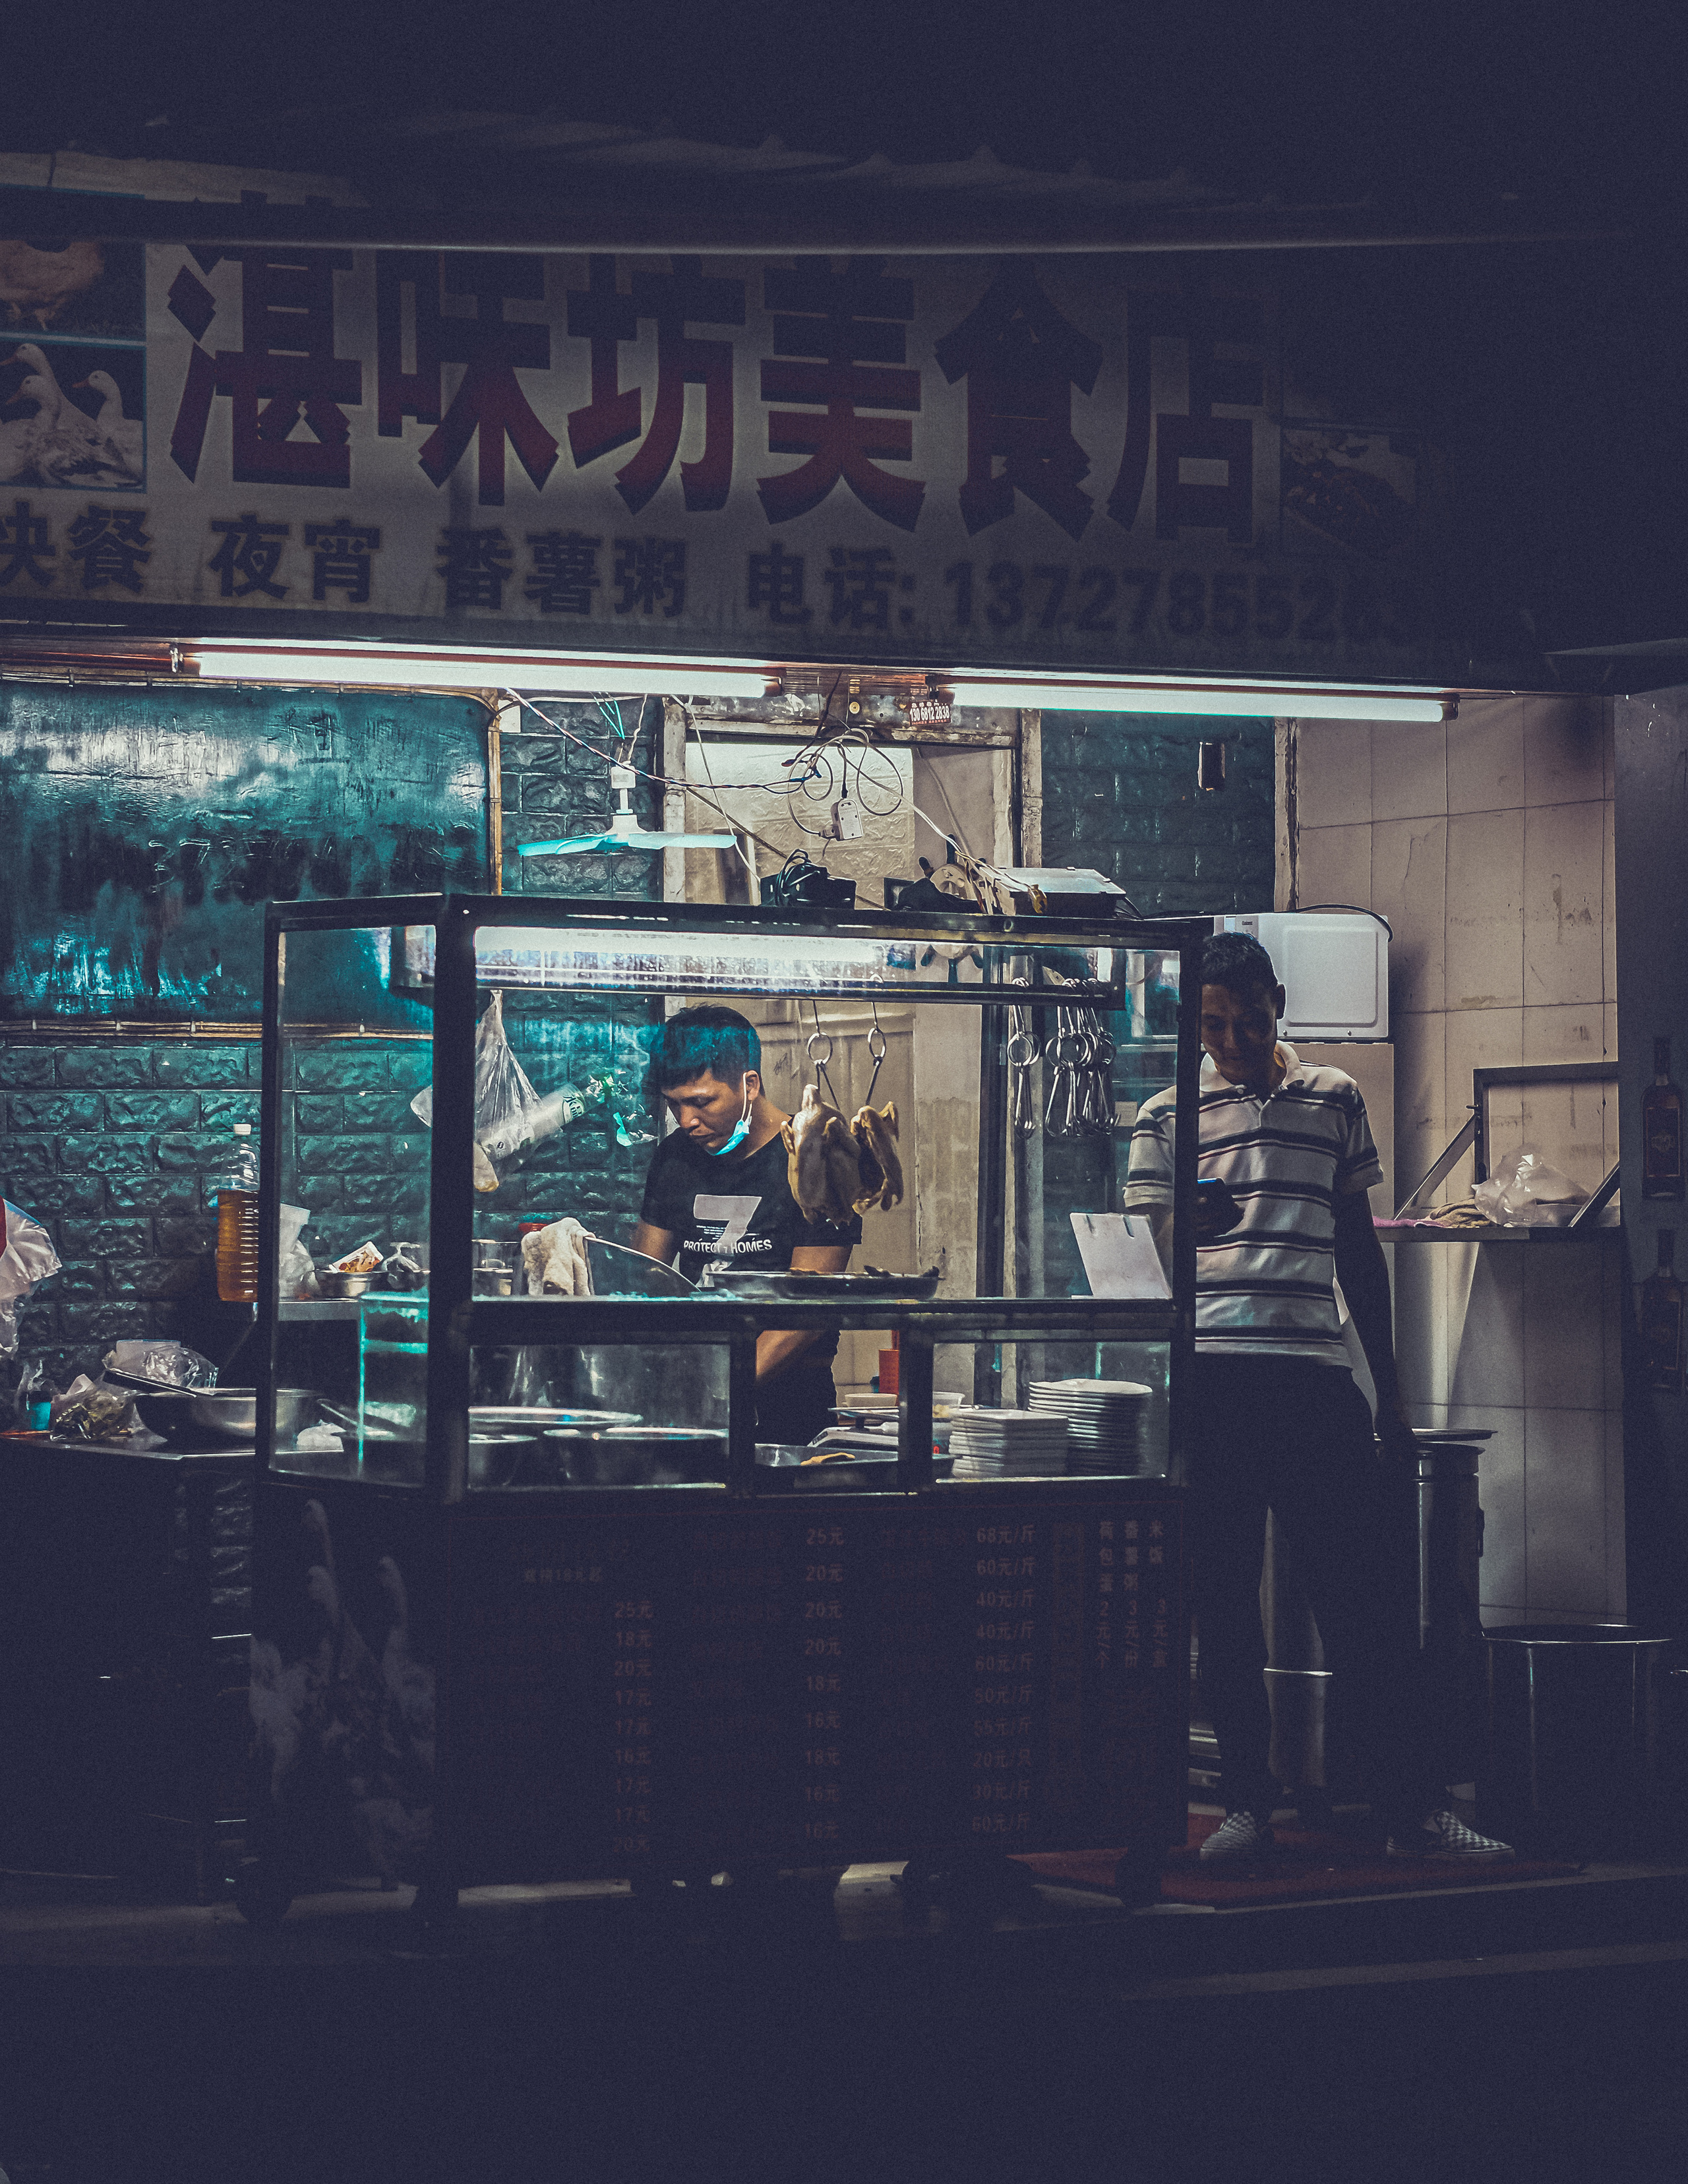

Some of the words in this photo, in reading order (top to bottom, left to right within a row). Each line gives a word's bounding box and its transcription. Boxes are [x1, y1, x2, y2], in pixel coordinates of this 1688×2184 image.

[168, 198, 1263, 545] 湛味坊美食店
[210, 514, 381, 603] 夜宵
[437, 529, 686, 618] 番薯粥
[745, 541, 916, 630] 电话:
[806, 1527, 844, 1545] 25元
[977, 1525, 1035, 1544] 68元/斤
[805, 1563, 843, 1582] 20元
[977, 1556, 1035, 1576] 60元/斤
[977, 1589, 1035, 1608] 40元/斤
[615, 1600, 653, 1619] 25元
[805, 1600, 842, 1619] 20元
[616, 1629, 652, 1648] 18元
[977, 1620, 1034, 1640] 40元/斤
[1095, 1601, 1111, 1669] 2元/个
[804, 1637, 841, 1656] 20元
[614, 1658, 651, 1677] 20元
[975, 1653, 1033, 1672] 60元/斤
[806, 1674, 841, 1692] 18元
[615, 1688, 651, 1706] 17元
[615, 1717, 651, 1735] 17元
[805, 1710, 840, 1728] 16元
[974, 1716, 1032, 1737] 55元/斤
[615, 1746, 651, 1765] 16元
[805, 1747, 840, 1765] 18元
[973, 1748, 1031, 1768] 20元/只
[616, 1776, 651, 1794] 17元
[805, 1784, 839, 1802] 16元
[615, 1805, 650, 1823] 17元
[972, 1812, 1030, 1833] 60元/斤
[804, 1821, 839, 1838] 16元
[613, 1834, 649, 1852] 20元
